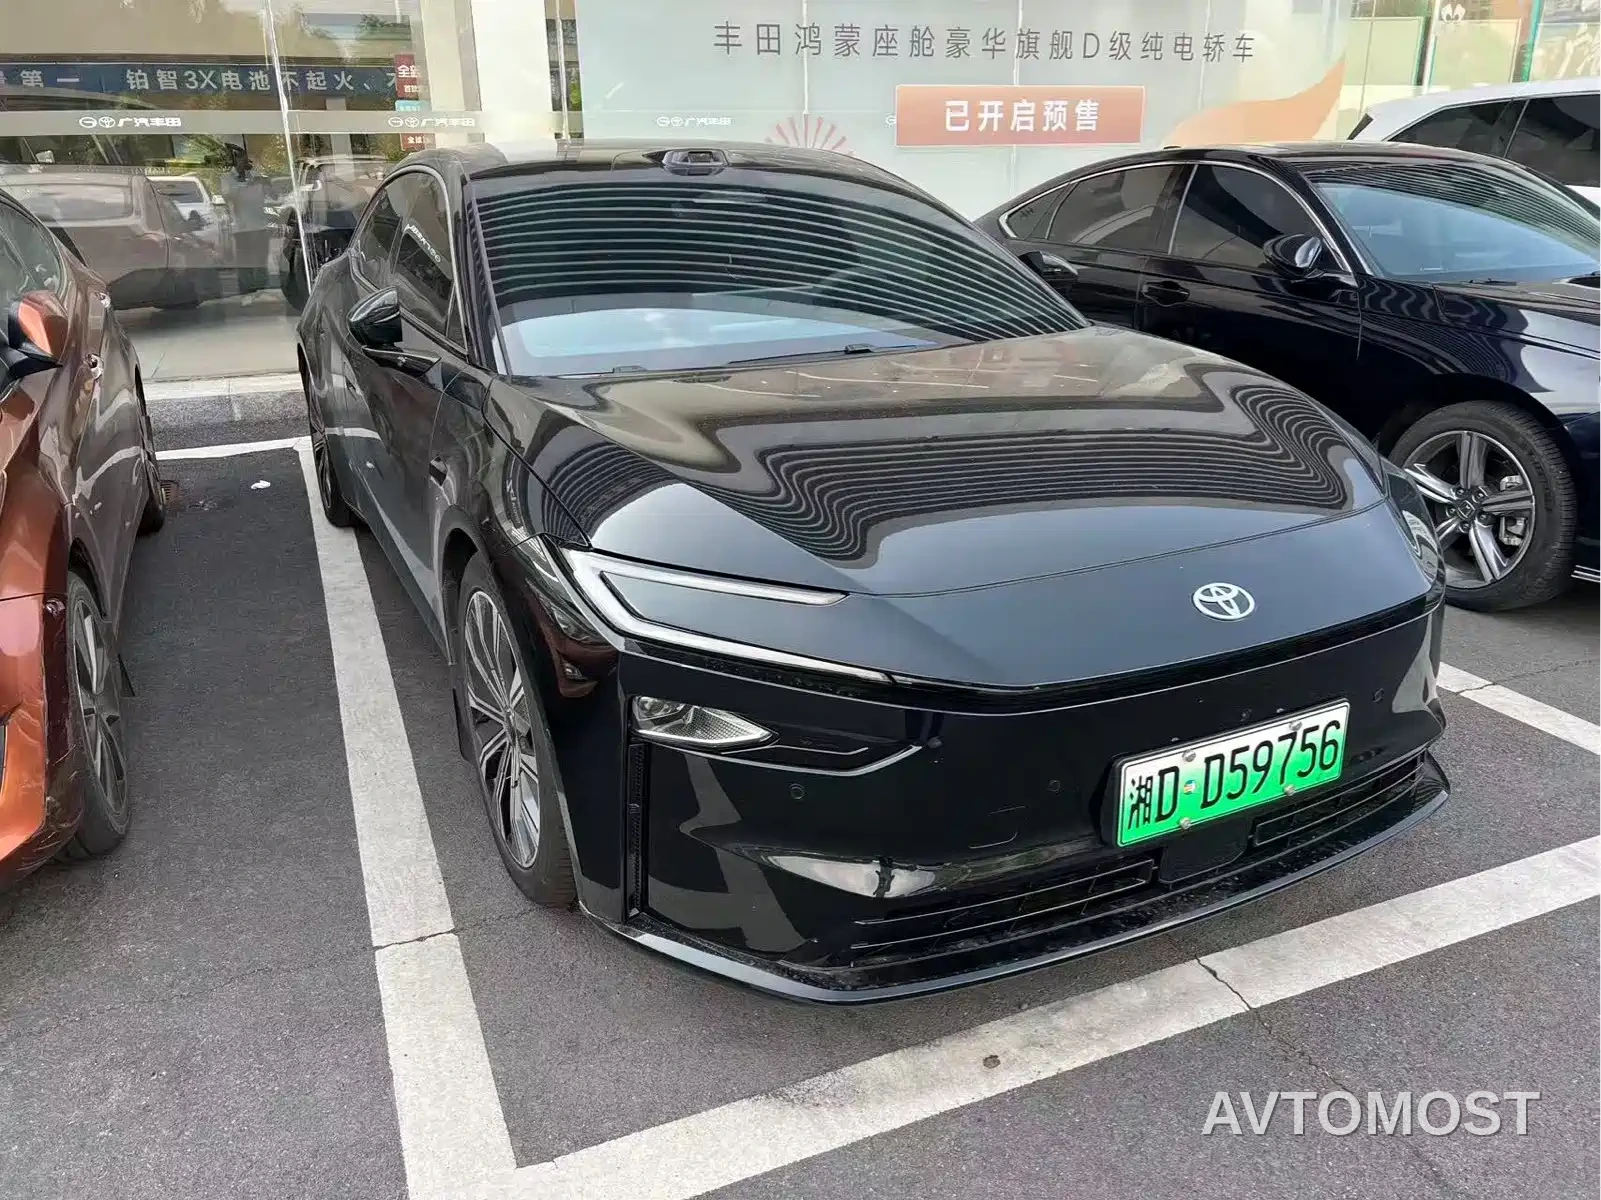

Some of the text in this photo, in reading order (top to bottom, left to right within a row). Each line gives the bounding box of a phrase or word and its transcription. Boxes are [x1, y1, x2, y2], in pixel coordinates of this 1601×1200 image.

[713, 20, 1255, 62] 丰田鸿蒙座舱豪华旗舰D级纯电轿车
[0, 69, 80, 88] 第一
[117, 117, 182, 127] 广汽丰田
[944, 99, 1100, 132] 已开启预售
